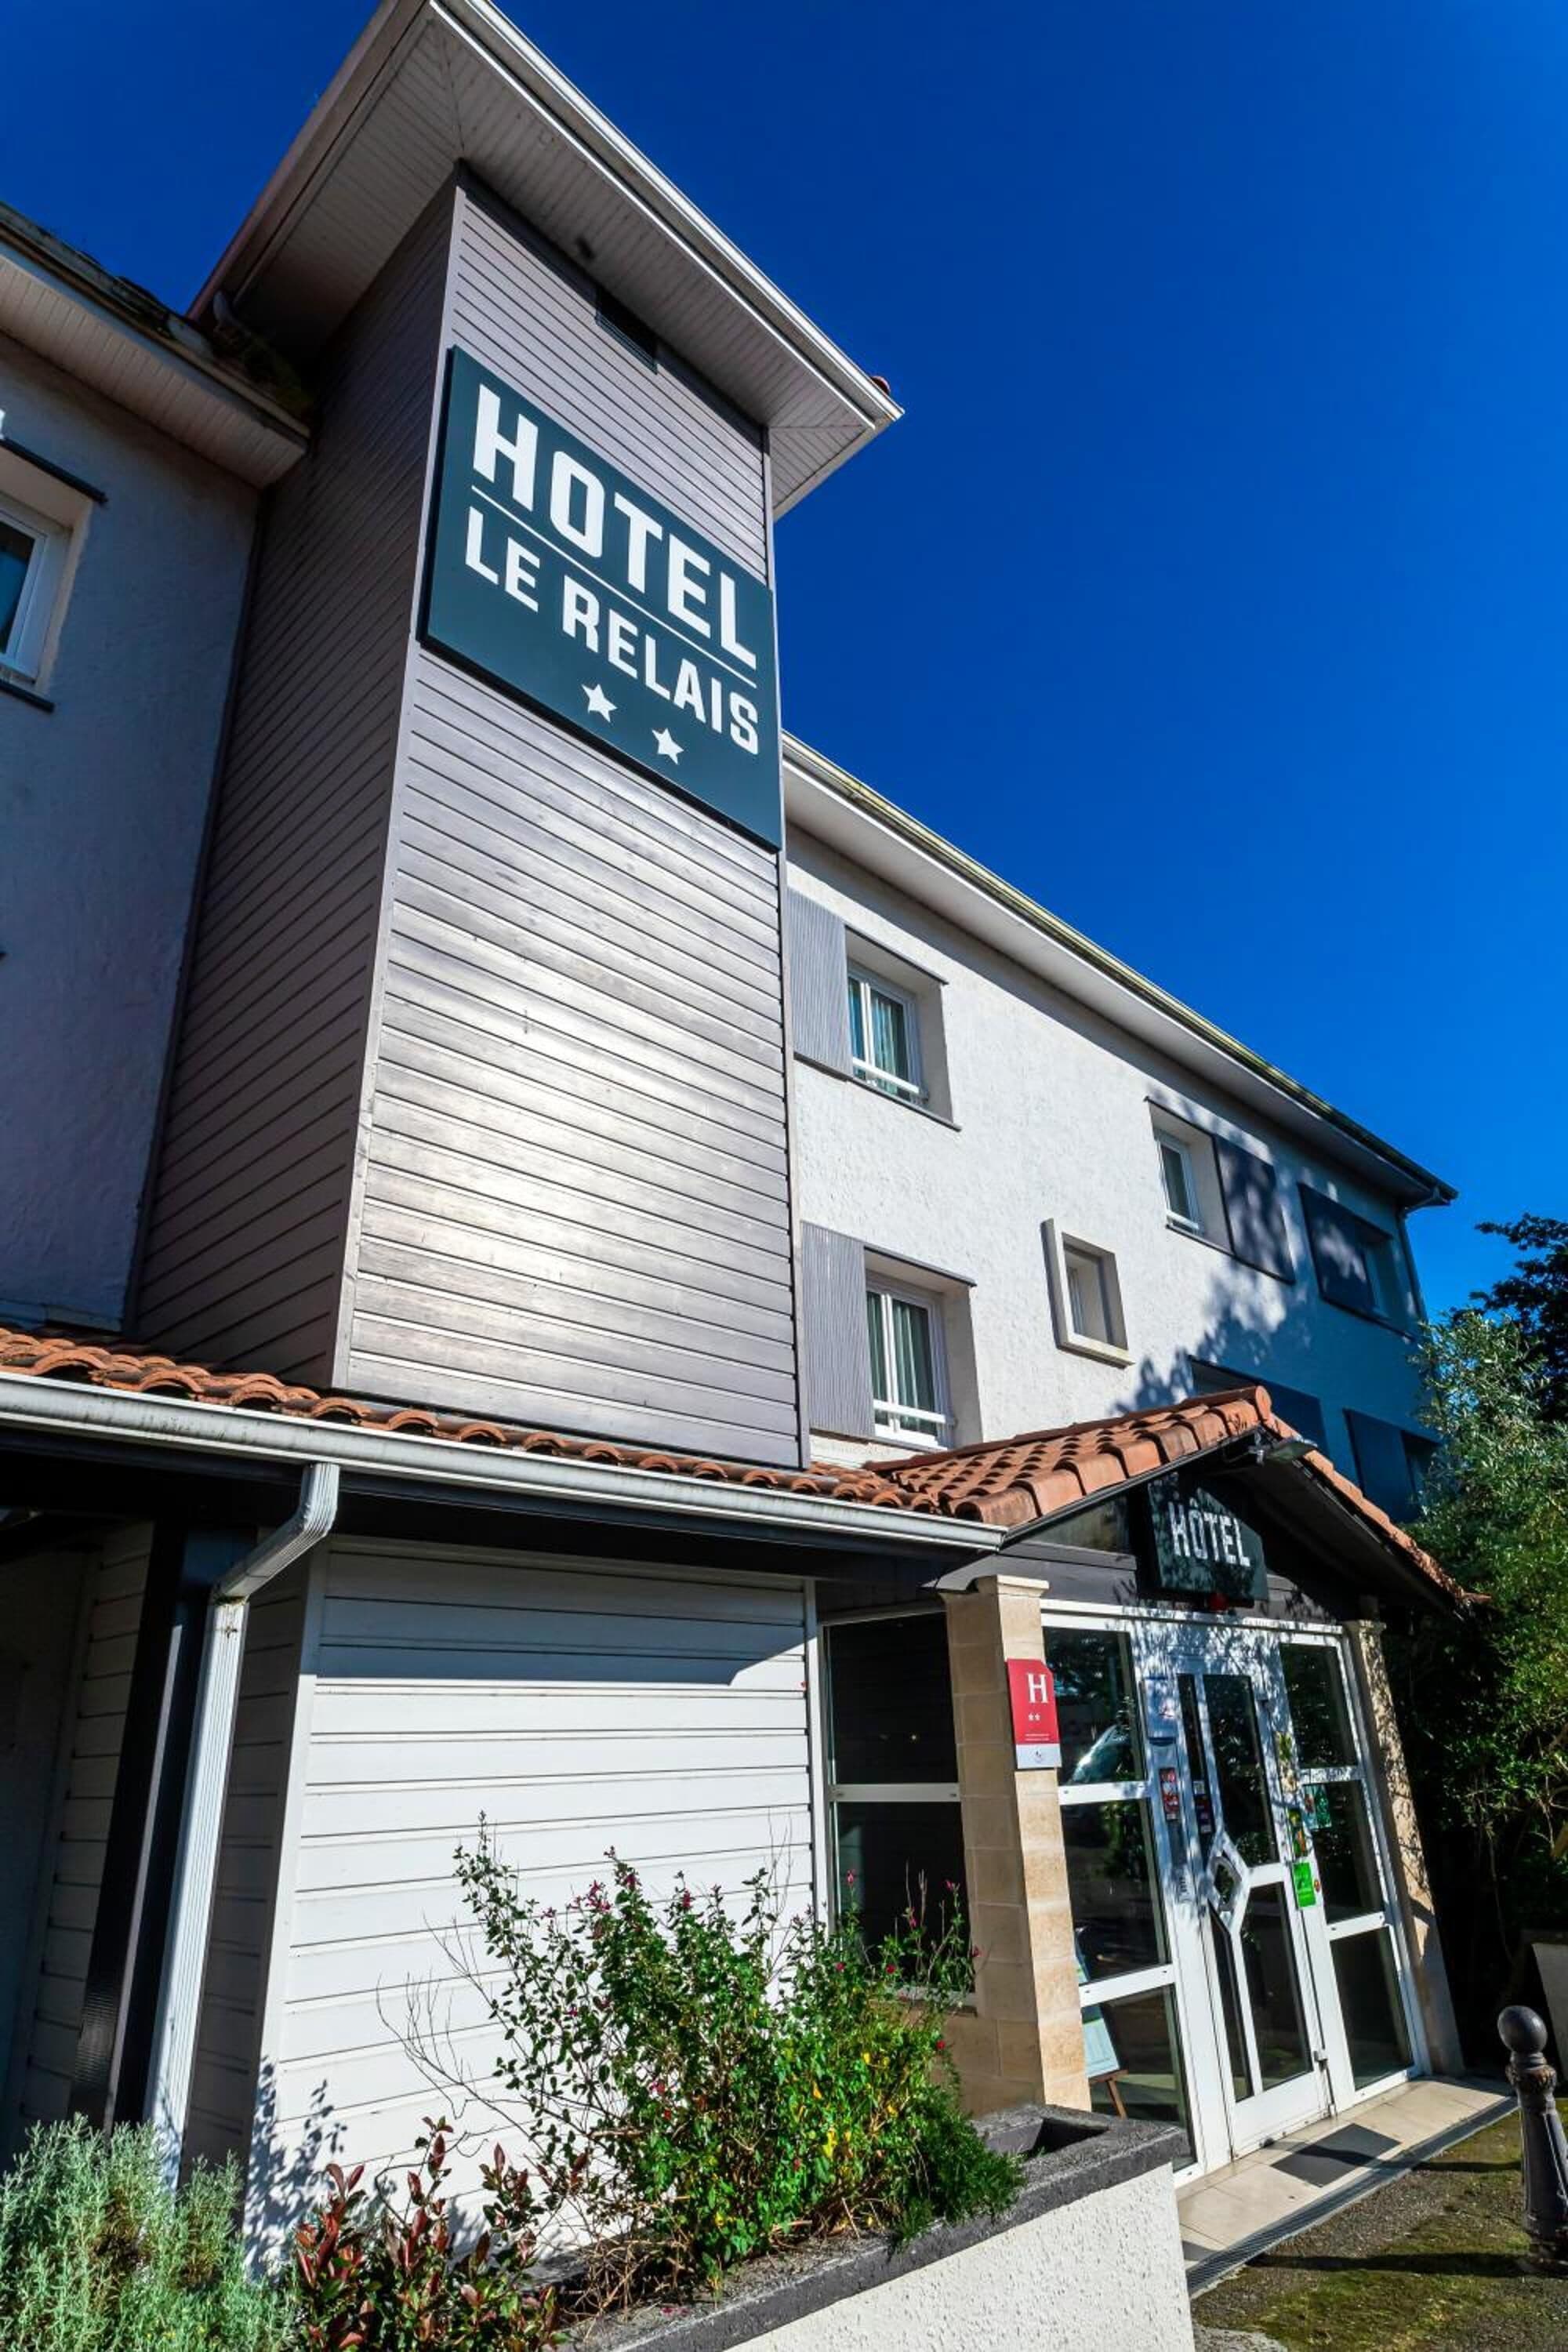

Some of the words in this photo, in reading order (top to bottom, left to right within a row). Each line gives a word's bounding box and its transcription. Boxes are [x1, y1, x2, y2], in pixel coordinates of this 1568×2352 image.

[465, 506, 541, 613] LE
[561, 574, 759, 756] RELAIS
[473, 383, 757, 671] HOTEL
[1026, 1672, 1048, 1704] H
